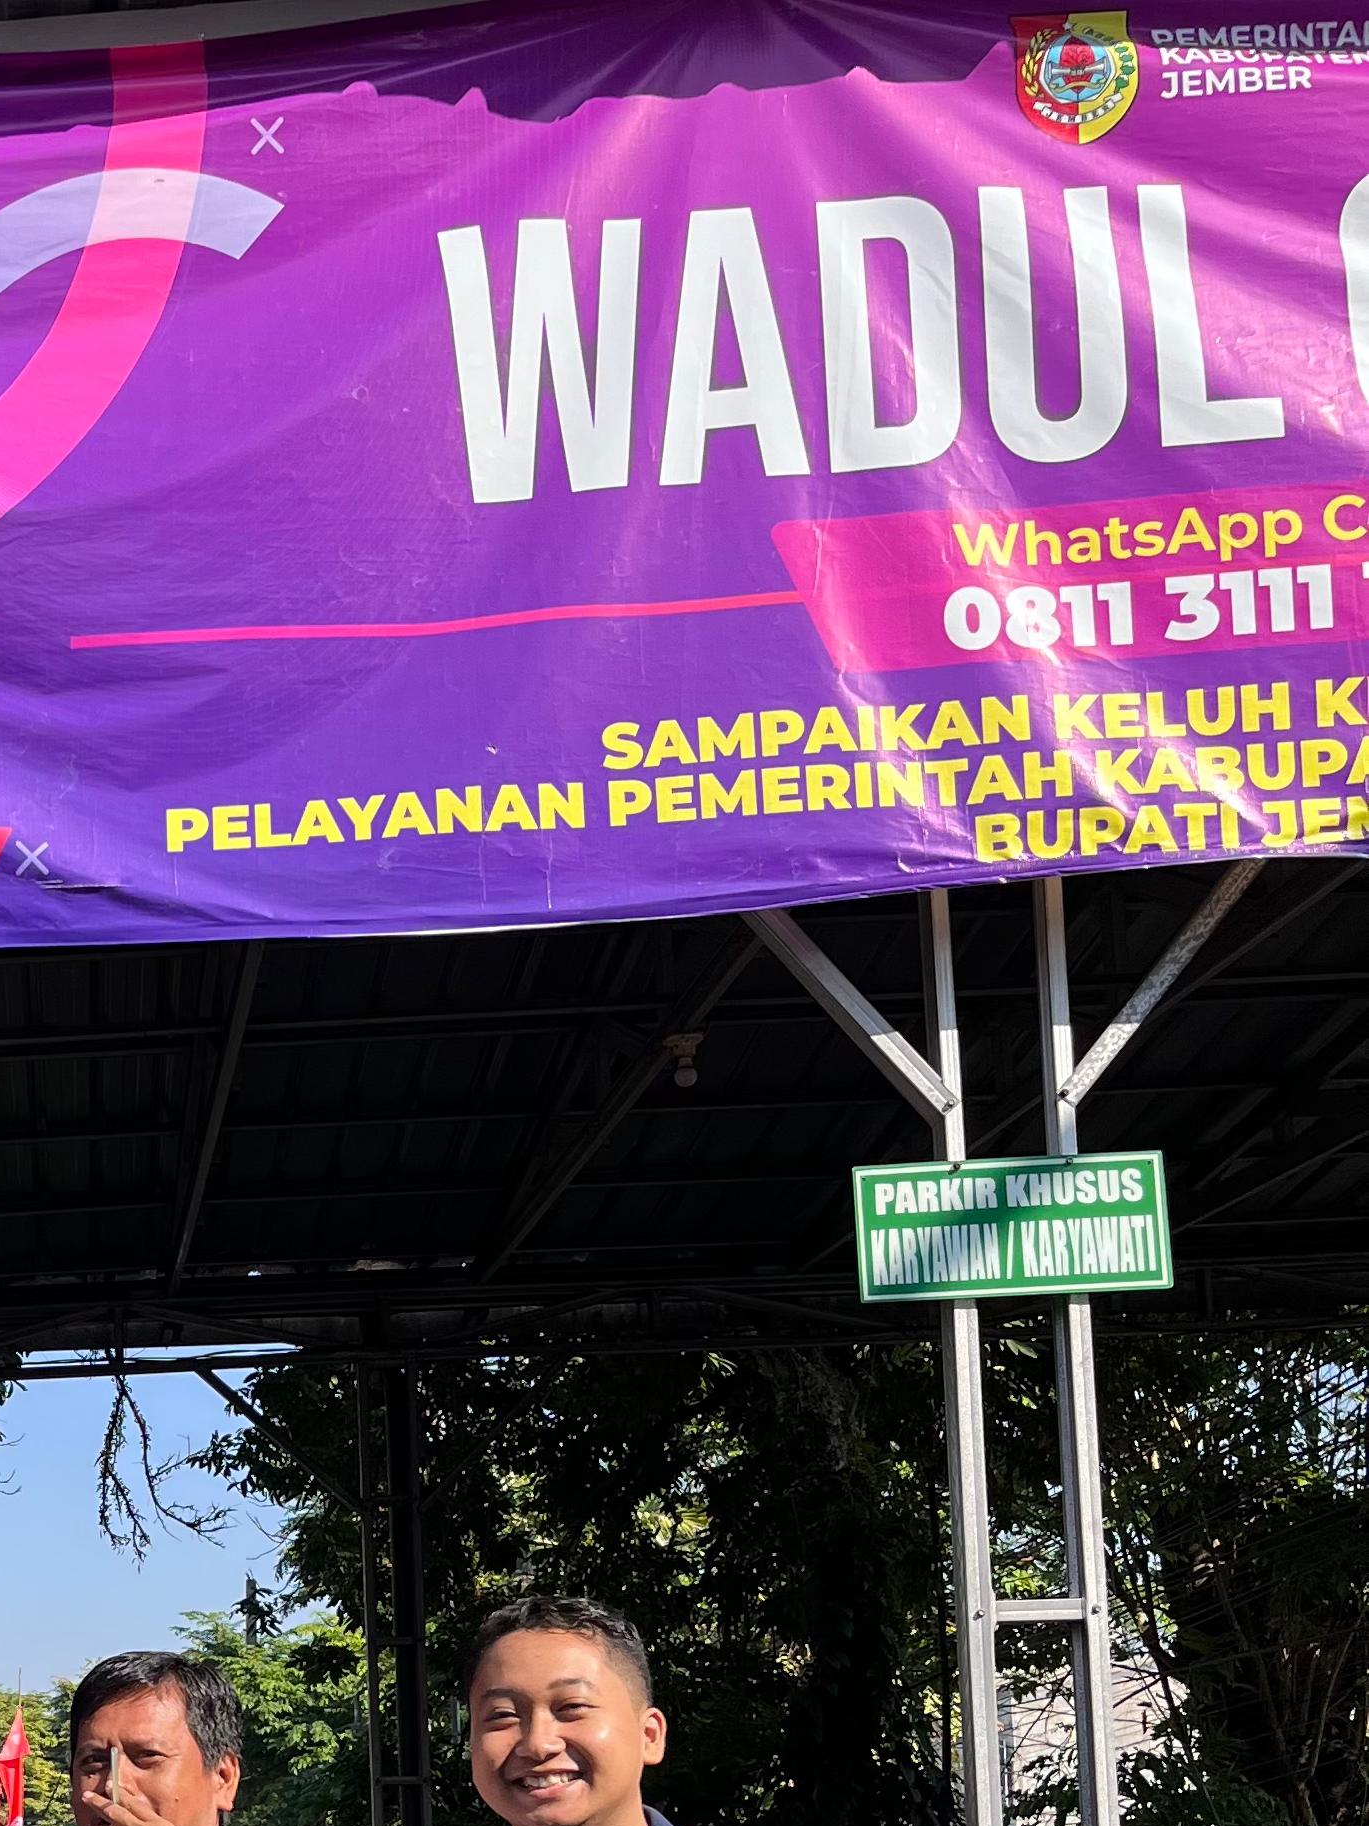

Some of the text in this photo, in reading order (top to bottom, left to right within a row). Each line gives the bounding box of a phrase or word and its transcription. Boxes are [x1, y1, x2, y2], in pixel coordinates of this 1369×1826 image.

[1151, 20, 1369, 48] PEMERINTA
[1160, 65, 1313, 100] JEMBER
[437, 183, 1286, 502] WADUL
[952, 494, 1369, 567] WhatsApp C
[943, 580, 1134, 651] 0811
[1163, 563, 1334, 641] 3111
[601, 676, 1369, 770] SAMPAIKAN KELUH K
[165, 781, 586, 853] PELAYANAN
[607, 749, 1074, 828] PEMERINTAH
[975, 802, 1241, 863] BUPATI
[874, 1167, 1145, 1216] PARKIR KHUSUS
[870, 1222, 1001, 1286] KARYAWAN
[1020, 1213, 1157, 1278] KARYAWATI
